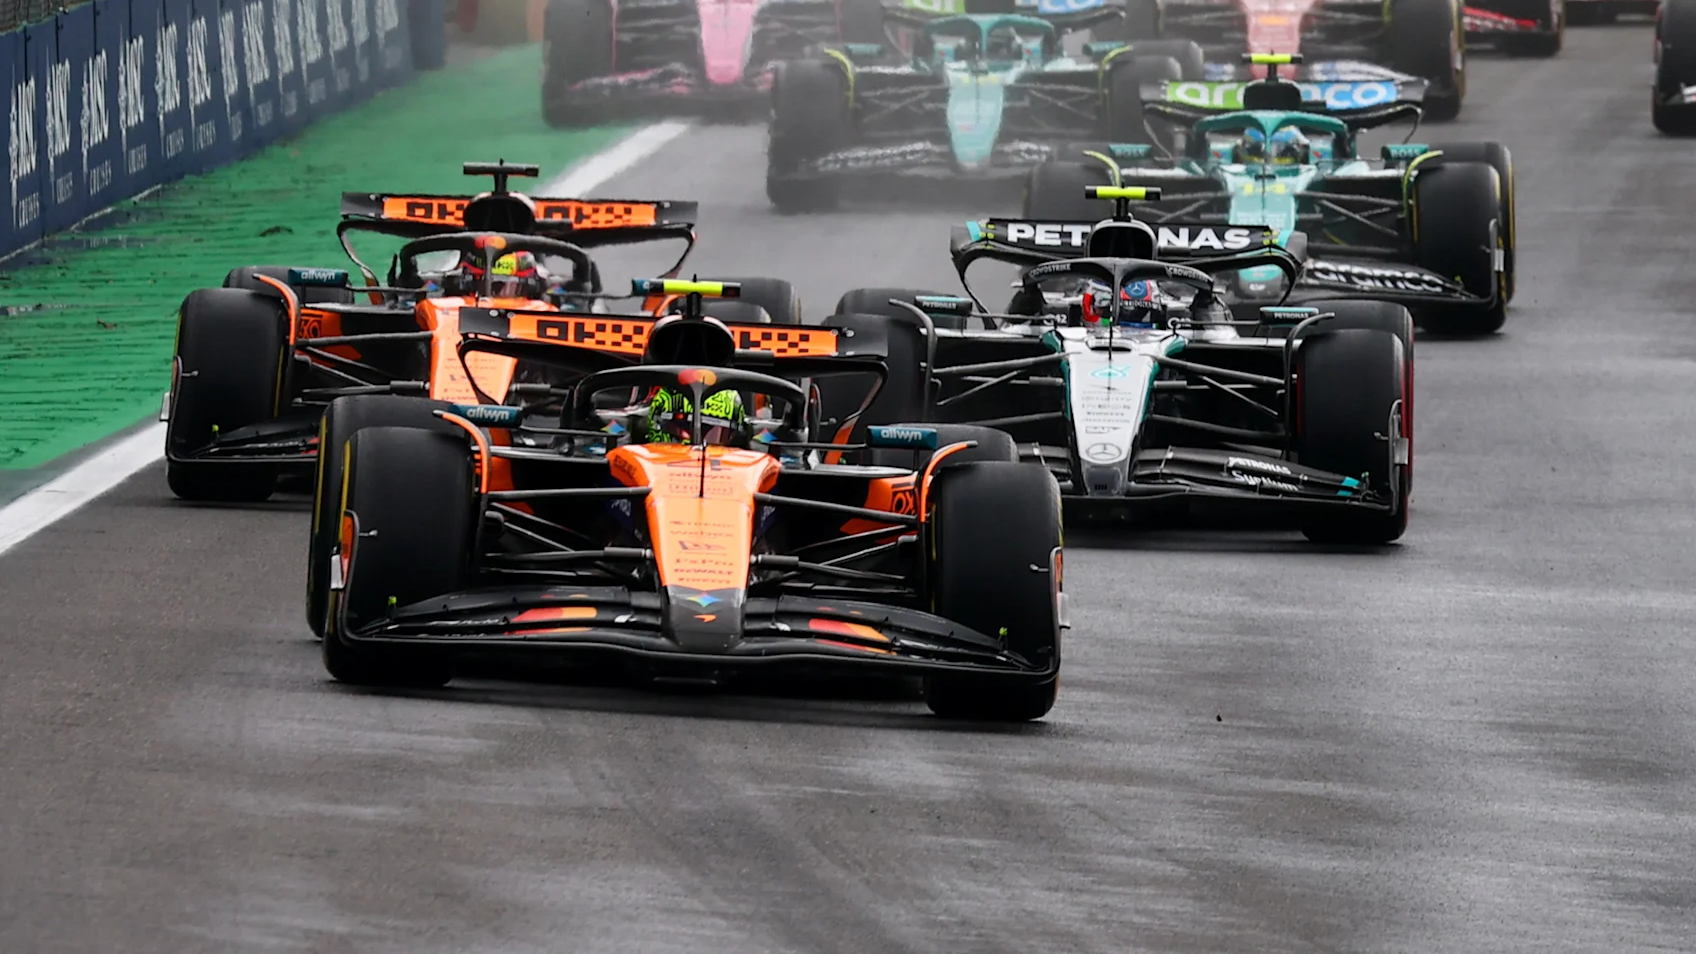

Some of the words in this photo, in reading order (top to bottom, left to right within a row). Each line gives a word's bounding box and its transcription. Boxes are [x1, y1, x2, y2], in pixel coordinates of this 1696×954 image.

[1175, 82, 1388, 108] arco
[1007, 223, 1251, 250] PETNAS
[301, 270, 335, 282] allwyn
[467, 408, 509, 423] allwyn
[881, 428, 922, 443] allwyn
[1229, 456, 1291, 474] PETRONAS
[1232, 470, 1300, 492] Syntium
